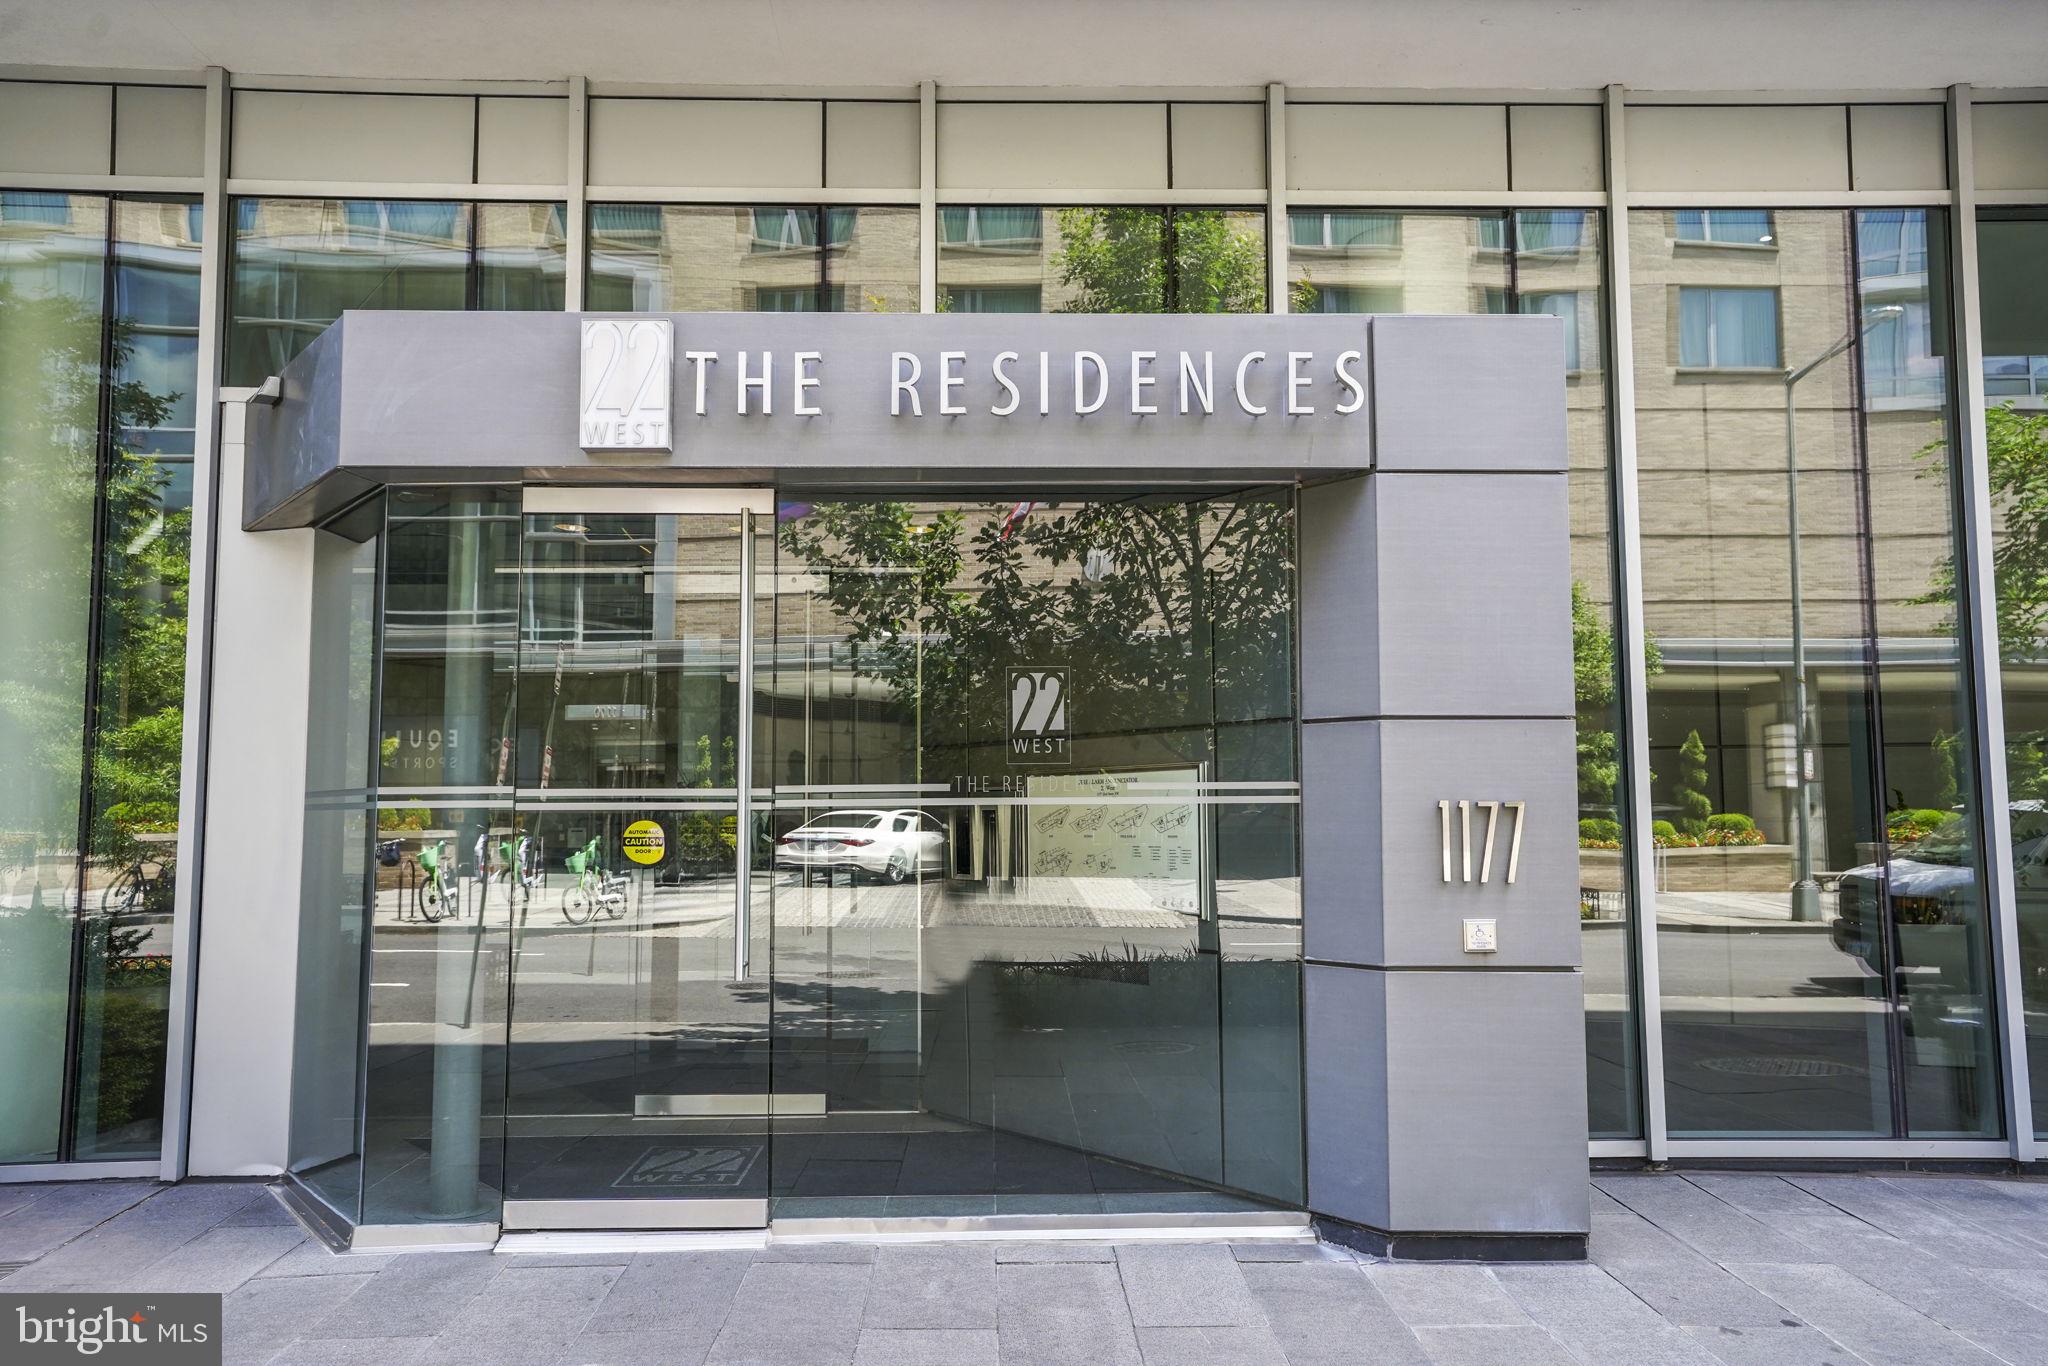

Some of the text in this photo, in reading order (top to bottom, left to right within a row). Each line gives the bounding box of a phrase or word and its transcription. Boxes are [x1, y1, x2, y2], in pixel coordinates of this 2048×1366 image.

[584, 320, 666, 417] 22
[685, 350, 1366, 418] THE RESIDENCES
[584, 422, 665, 446] WEST
[1011, 671, 1065, 735] 22
[1012, 738, 1066, 754] WEST
[954, 775, 990, 793] THE
[1438, 800, 1526, 883] 1177
[631, 1173, 735, 1183] WEST
